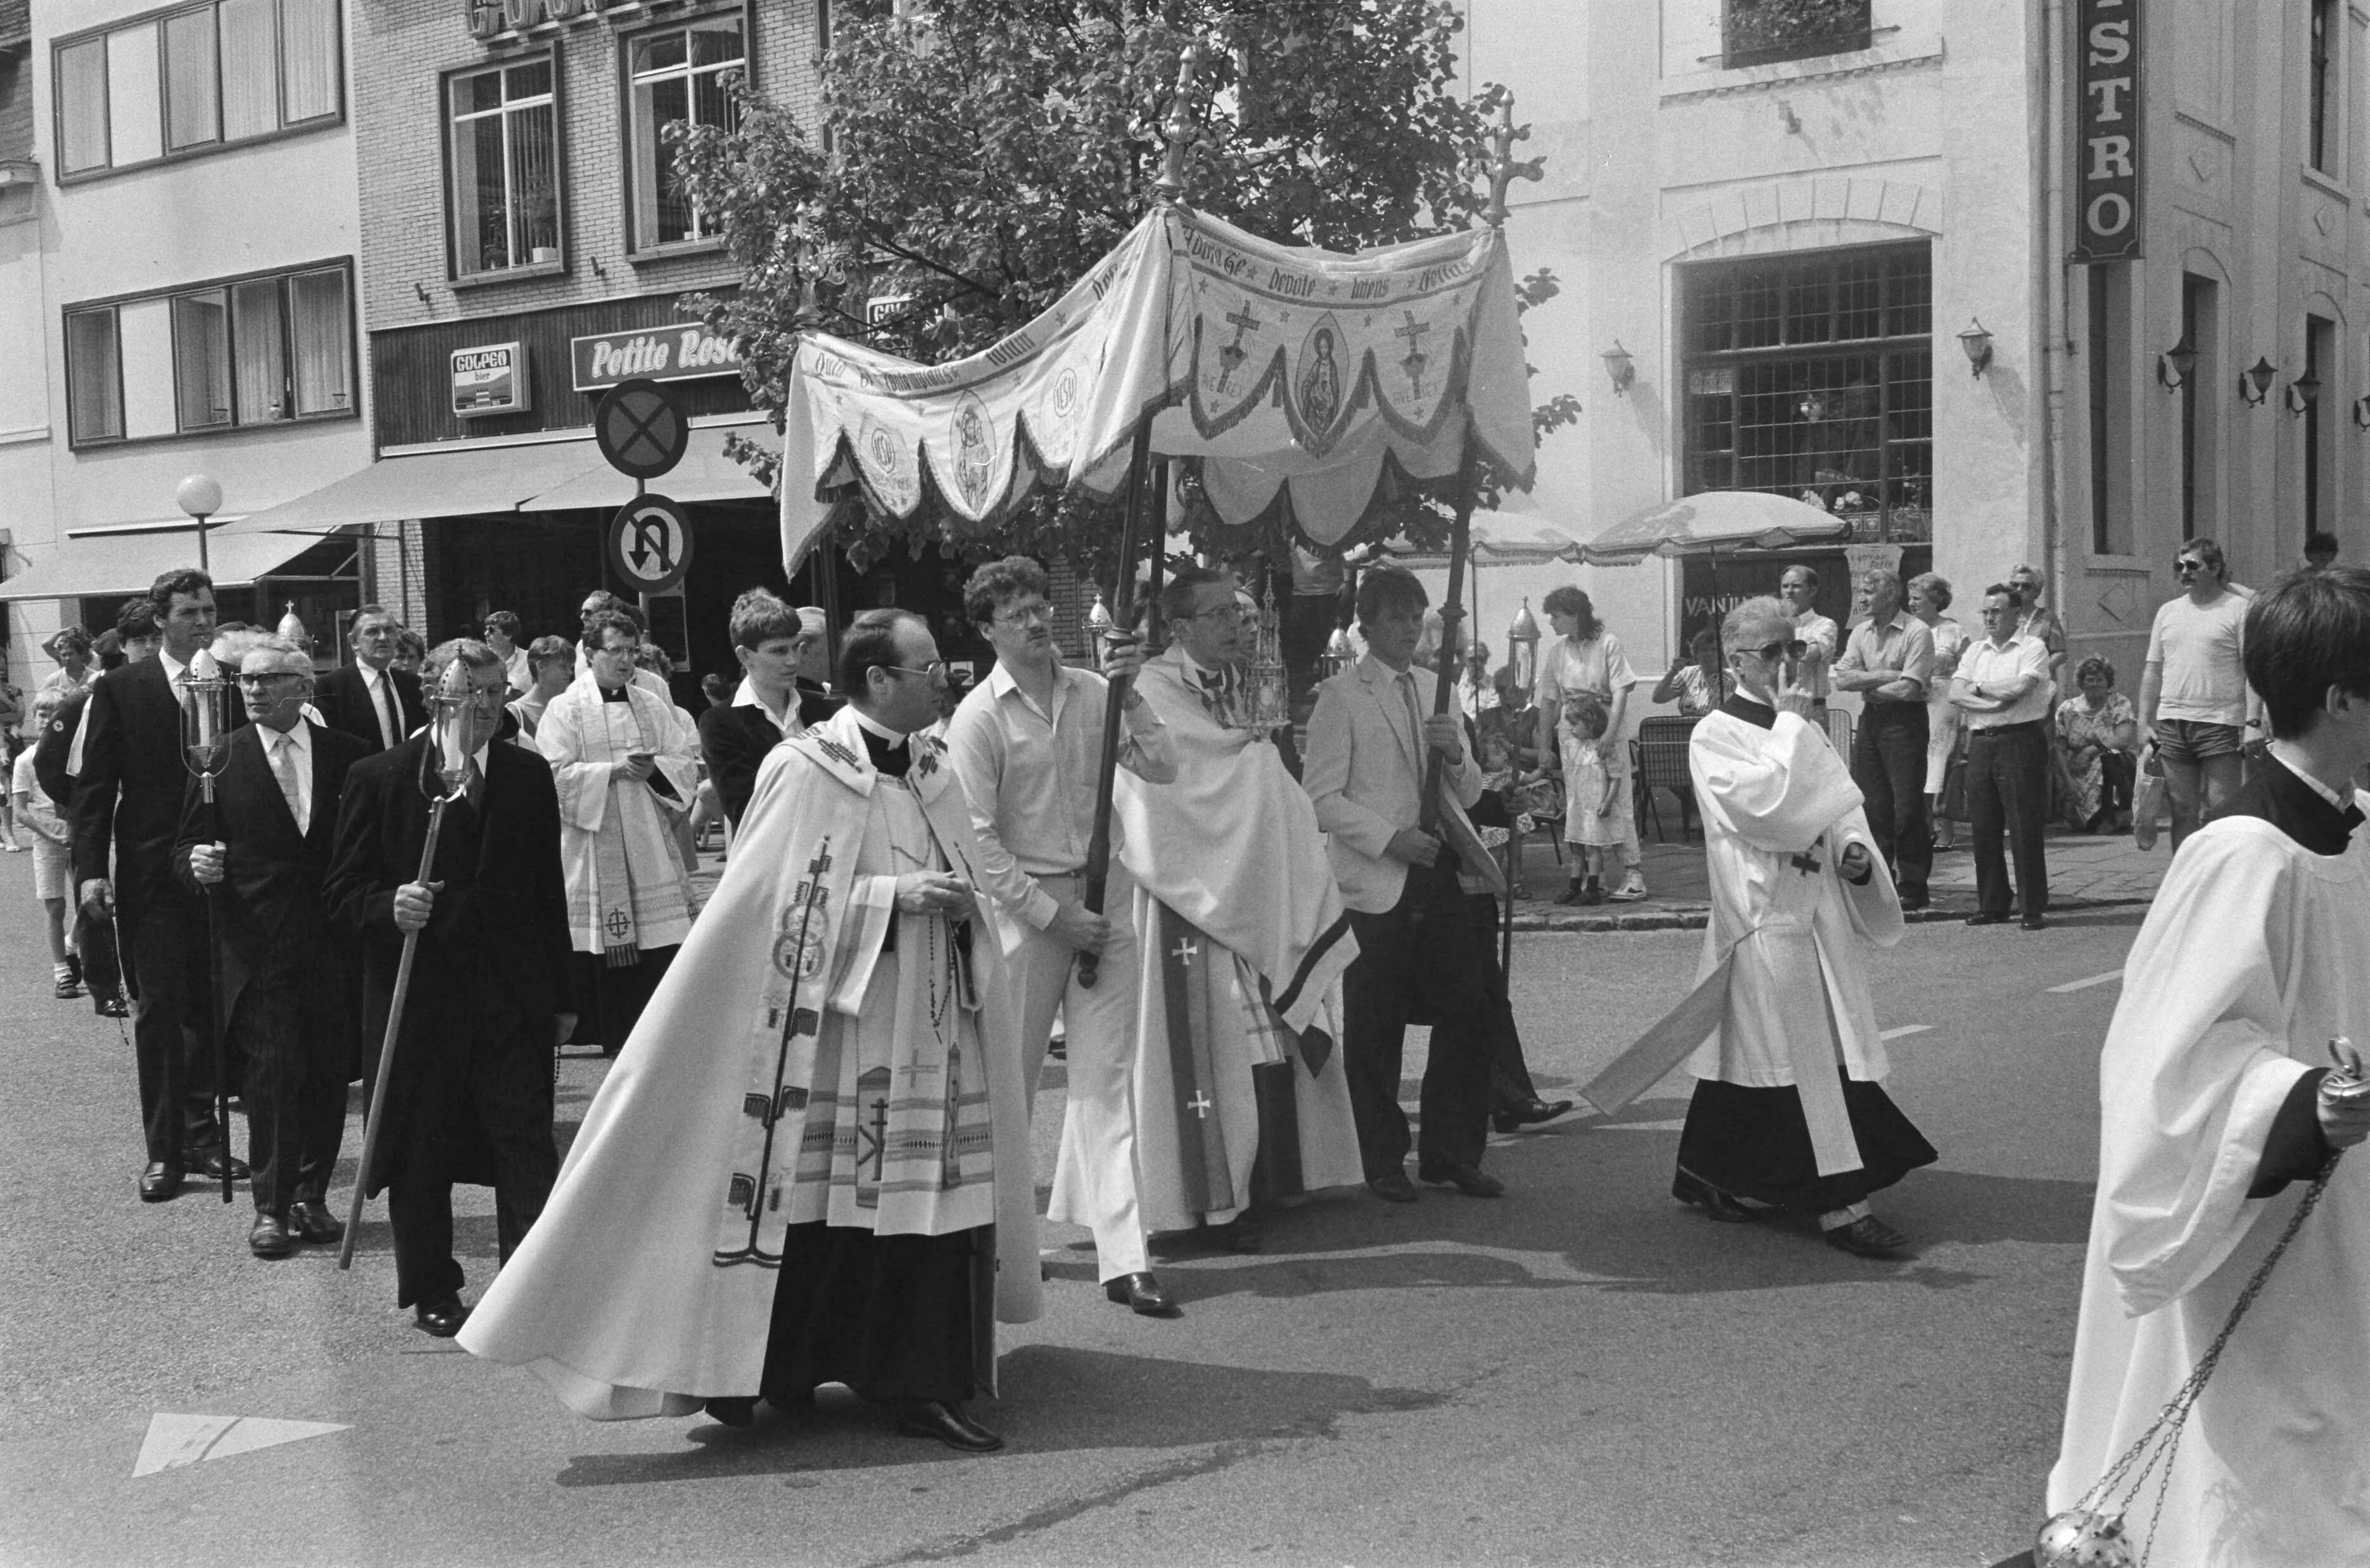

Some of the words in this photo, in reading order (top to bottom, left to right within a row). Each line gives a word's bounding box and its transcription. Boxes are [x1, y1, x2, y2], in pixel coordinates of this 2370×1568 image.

[2086, 0, 2134, 237] STRO
[475, 371, 490, 381] bier
[592, 336, 669, 379] Petite
